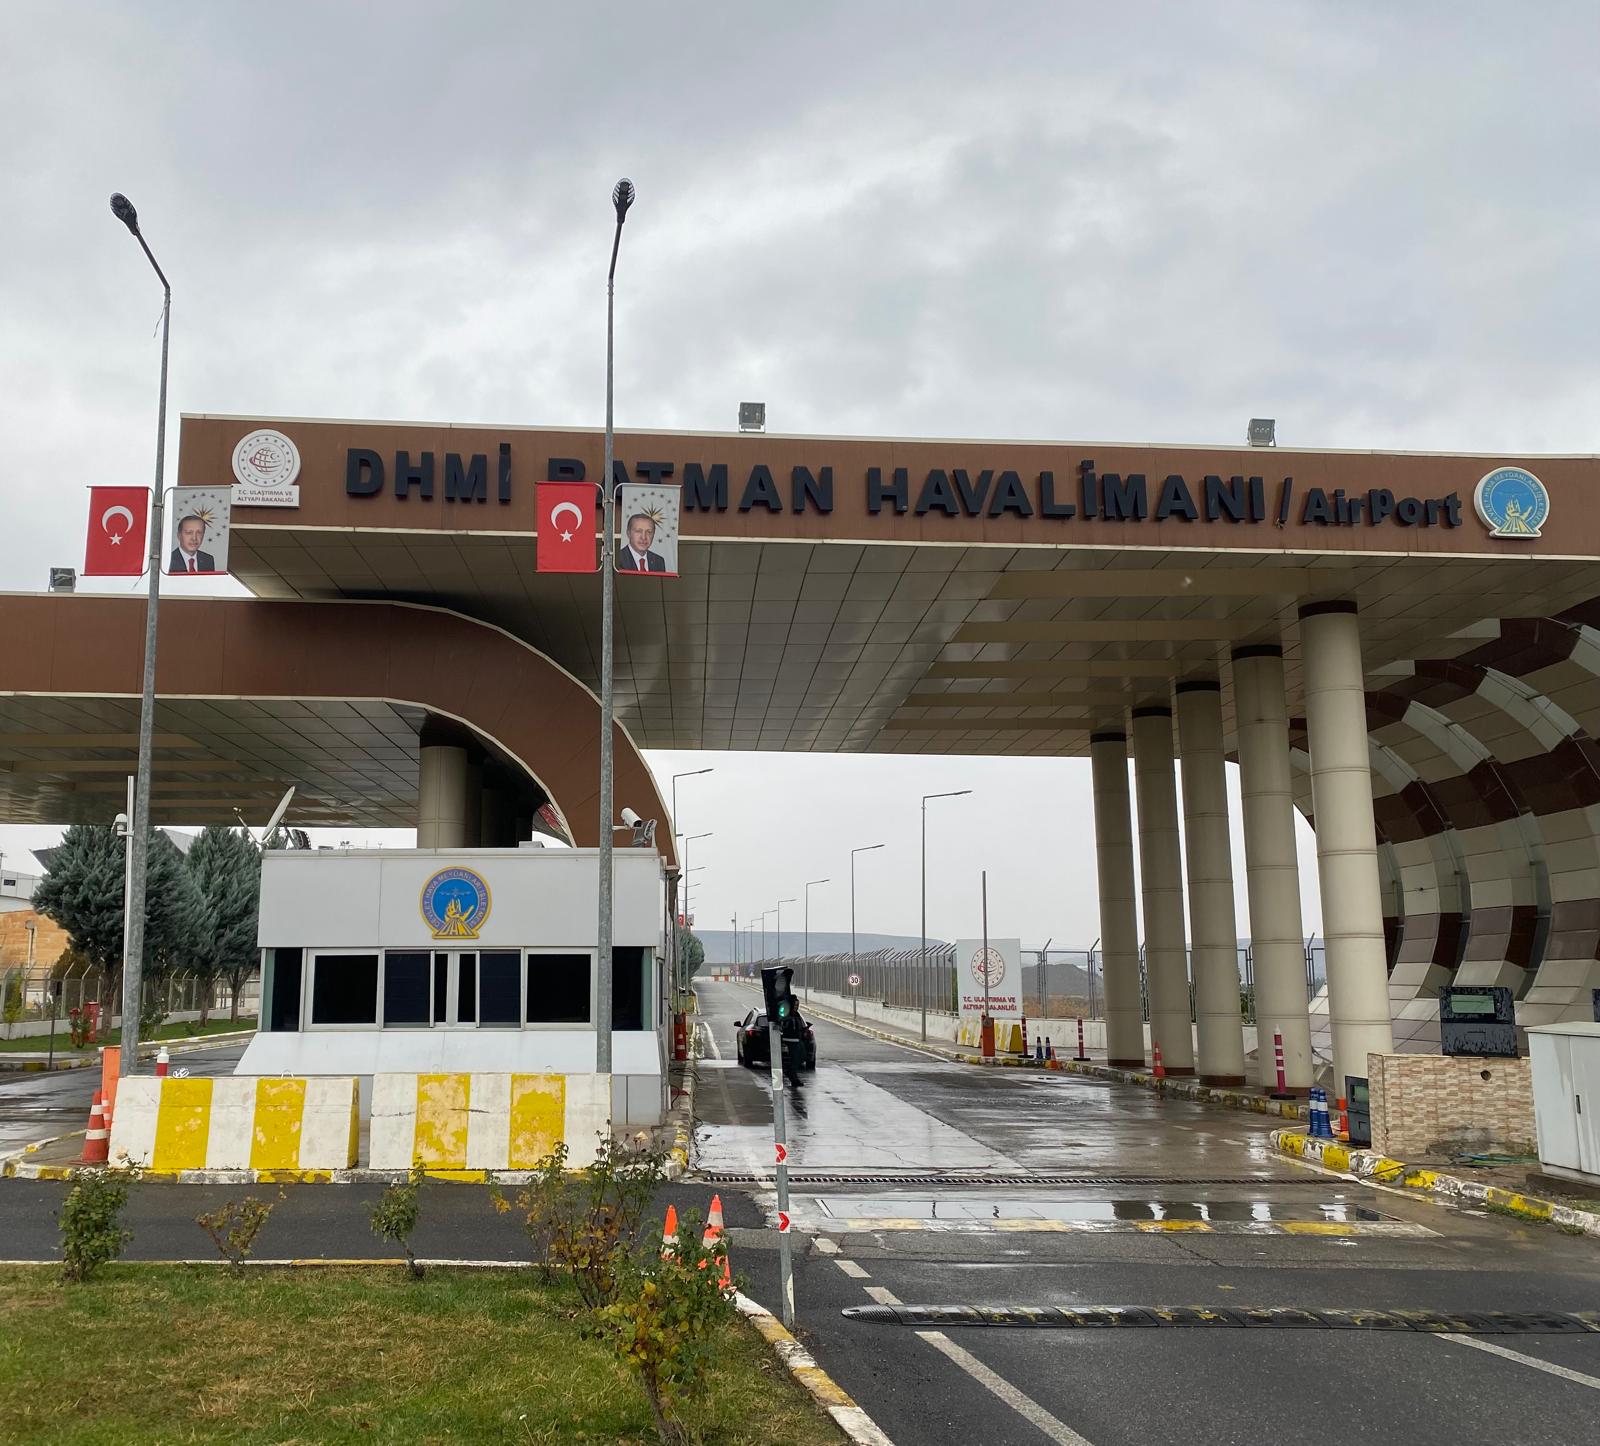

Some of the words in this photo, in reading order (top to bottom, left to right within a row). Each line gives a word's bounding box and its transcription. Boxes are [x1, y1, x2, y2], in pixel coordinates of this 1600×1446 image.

[347, 442, 512, 503] DHMİ
[867, 459, 1267, 522] HAVALİMANI
[1302, 487, 1463, 528] AirPort
